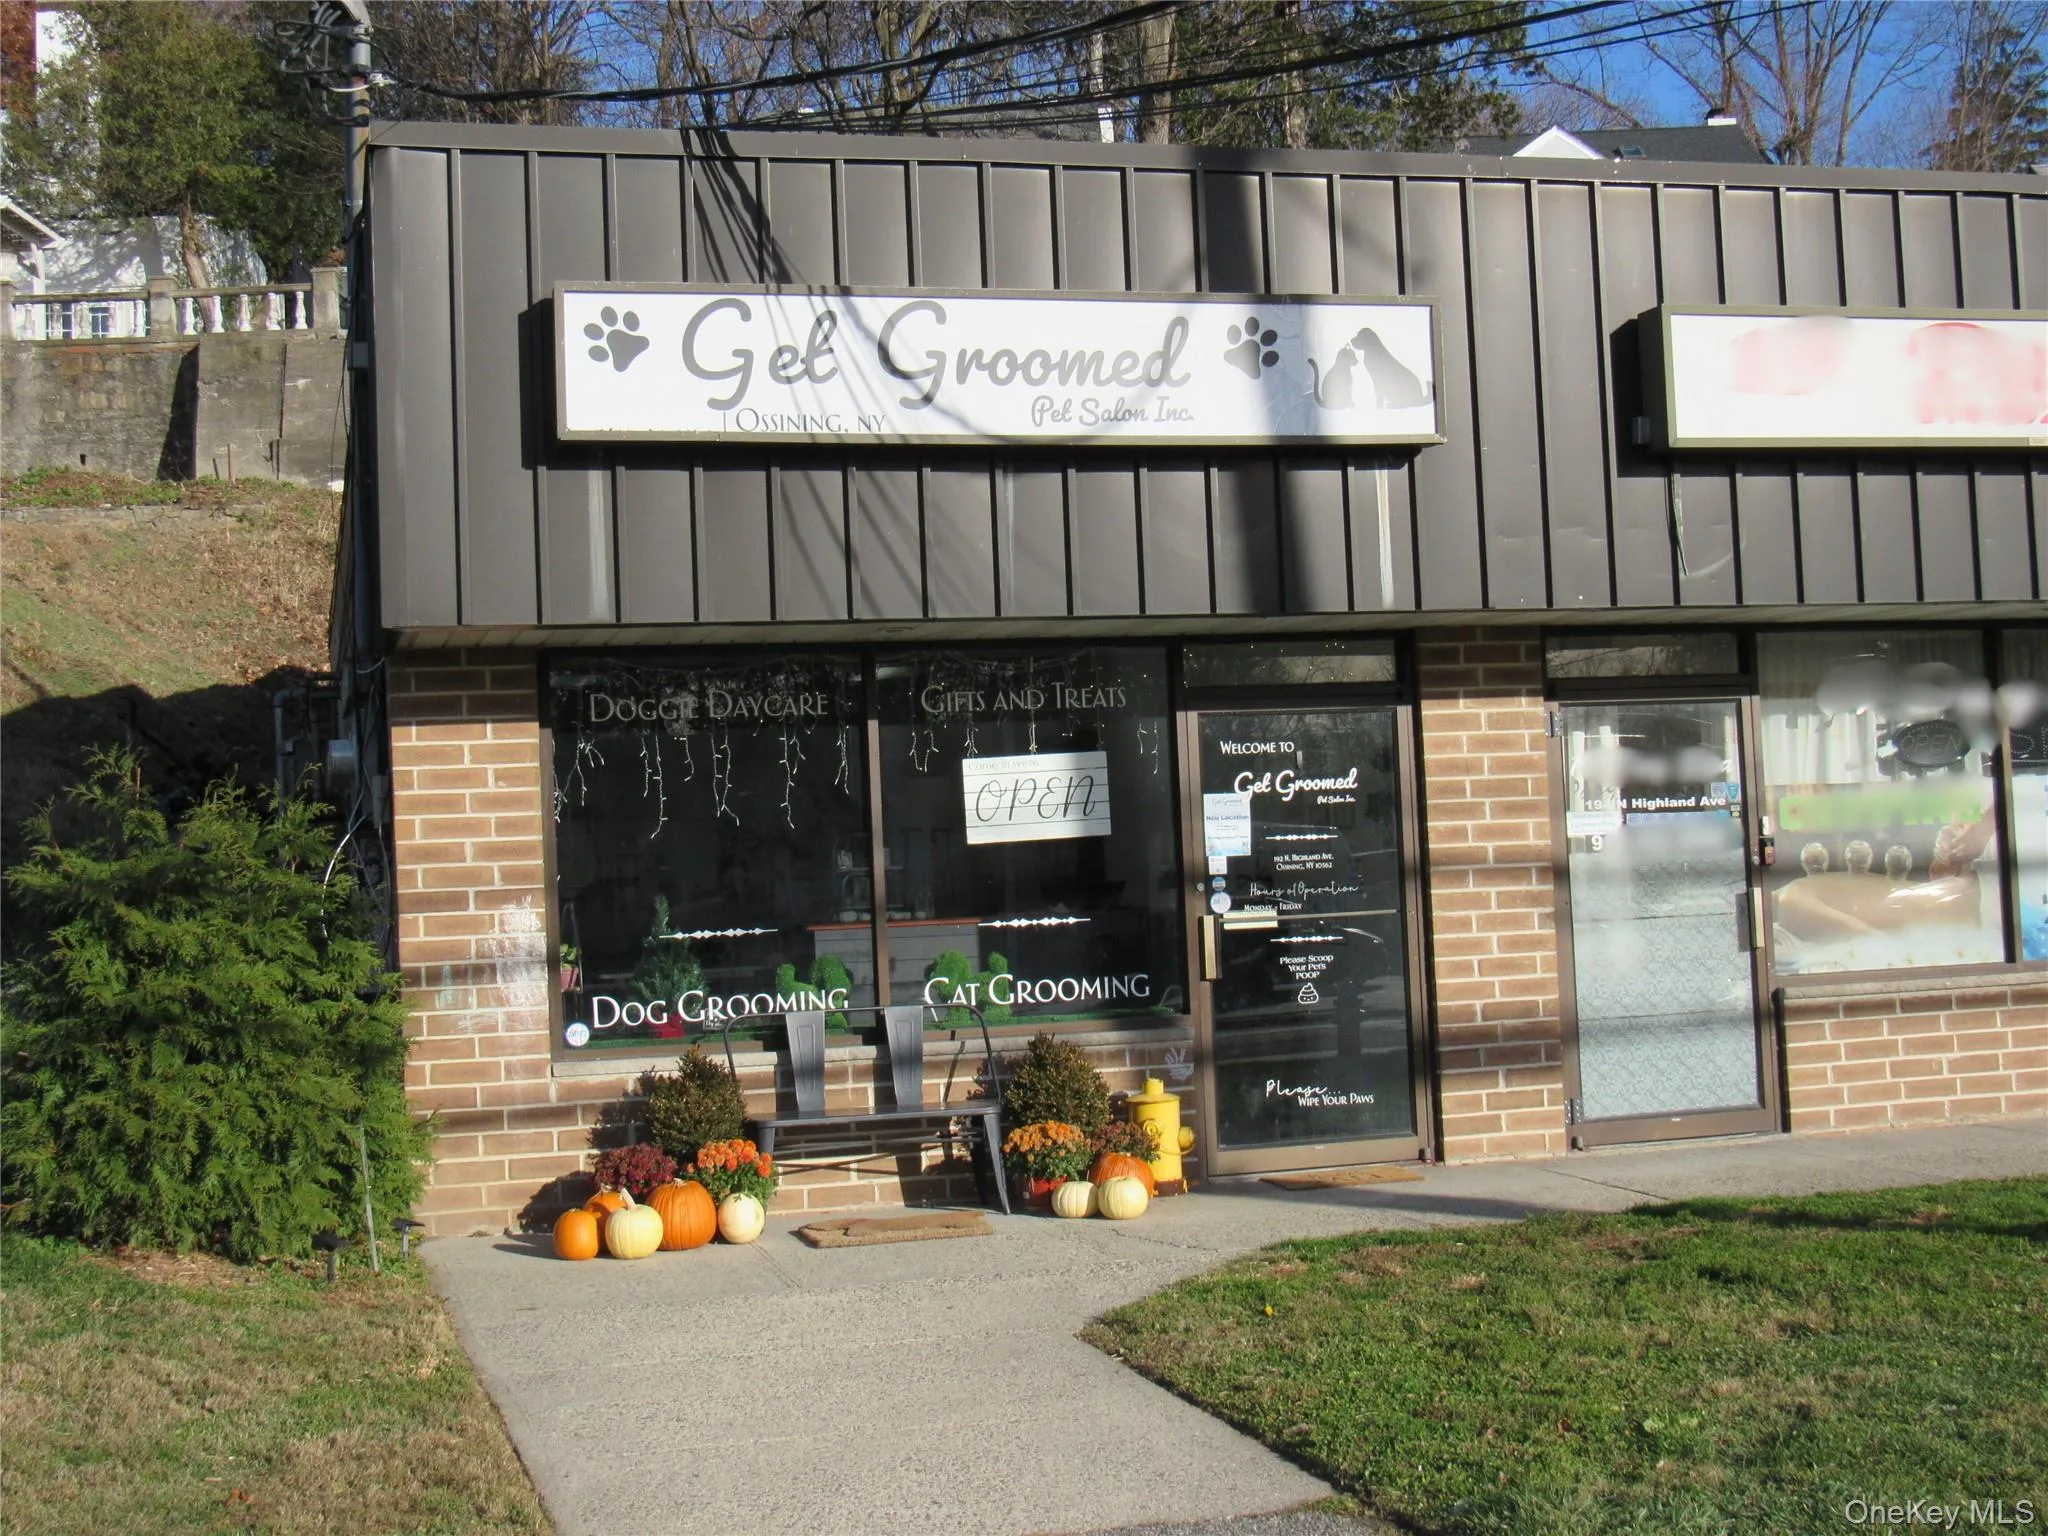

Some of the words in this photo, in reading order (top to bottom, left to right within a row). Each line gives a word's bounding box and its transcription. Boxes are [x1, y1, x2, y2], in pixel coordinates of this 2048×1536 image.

[682, 298, 838, 410] Get
[877, 300, 1192, 410] Groomed
[1031, 395, 1073, 427] Pet
[1079, 397, 1149, 426] Salon
[1154, 396, 1195, 423] Inc.
[857, 413, 887, 432] NY
[590, 693, 700, 723] DOGGIE
[709, 689, 829, 719] DAYCARE
[921, 685, 985, 713] GIFTS
[993, 687, 1045, 711] AND
[1051, 682, 1127, 710] TREATS
[1220, 740, 1276, 755] WELCOME
[1278, 741, 1295, 753] TO
[1234, 771, 1272, 801] Get
[1275, 768, 1358, 801] Groomed
[975, 774, 1096, 823] OPEN
[1616, 799, 1627, 809] N
[1632, 796, 1696, 810] Highland
[1700, 796, 1727, 806] Ave
[1250, 882, 1284, 897] Hours
[1298, 881, 1359, 900] Operation
[1244, 904, 1273, 912] MONDAY
[1279, 902, 1302, 910] FRIDAY
[1280, 956, 1307, 965] Please
[1308, 954, 1334, 965] Scoop
[1288, 963, 1306, 972] Your
[1296, 970, 1320, 980] POOP
[923, 976, 980, 1006] CAT
[988, 973, 1150, 1006] GROOMING
[592, 995, 668, 1029] DOG
[677, 988, 850, 1024] GROOMING
[1298, 1095, 1320, 1107] WIPE
[1322, 1093, 1348, 1106] YOUR
[1350, 1092, 1375, 1104] PAWS
